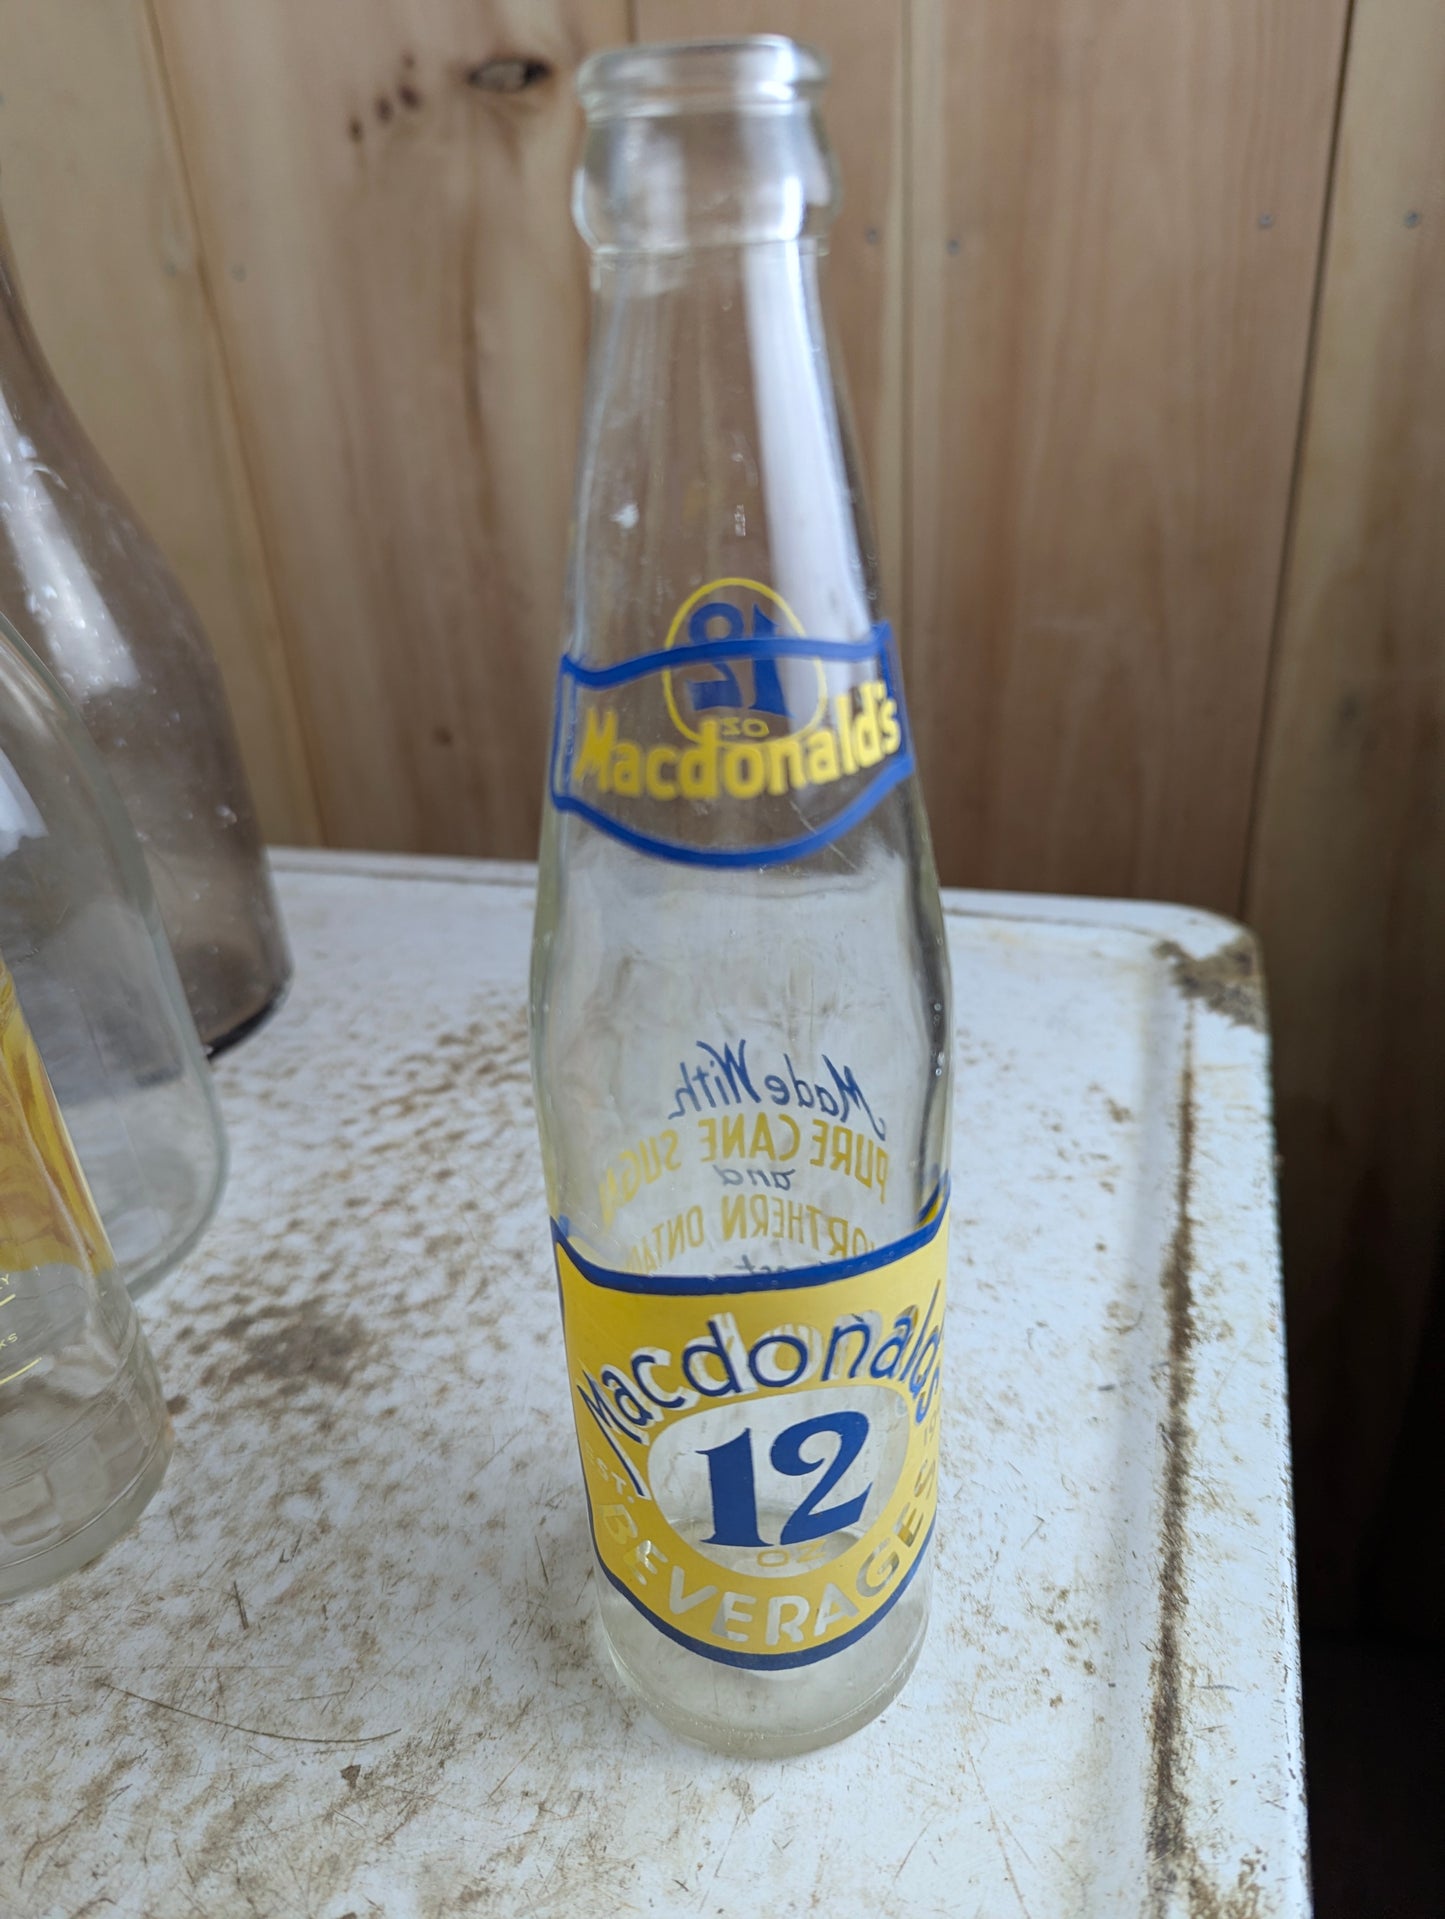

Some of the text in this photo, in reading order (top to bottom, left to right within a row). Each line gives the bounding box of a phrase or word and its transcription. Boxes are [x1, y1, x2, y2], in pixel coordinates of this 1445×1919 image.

[574, 680, 902, 799] Macdonald's
[695, 1411, 873, 1547] 12
[599, 1458, 937, 1646] BEVERAGES
[756, 1540, 827, 1568] OZ
